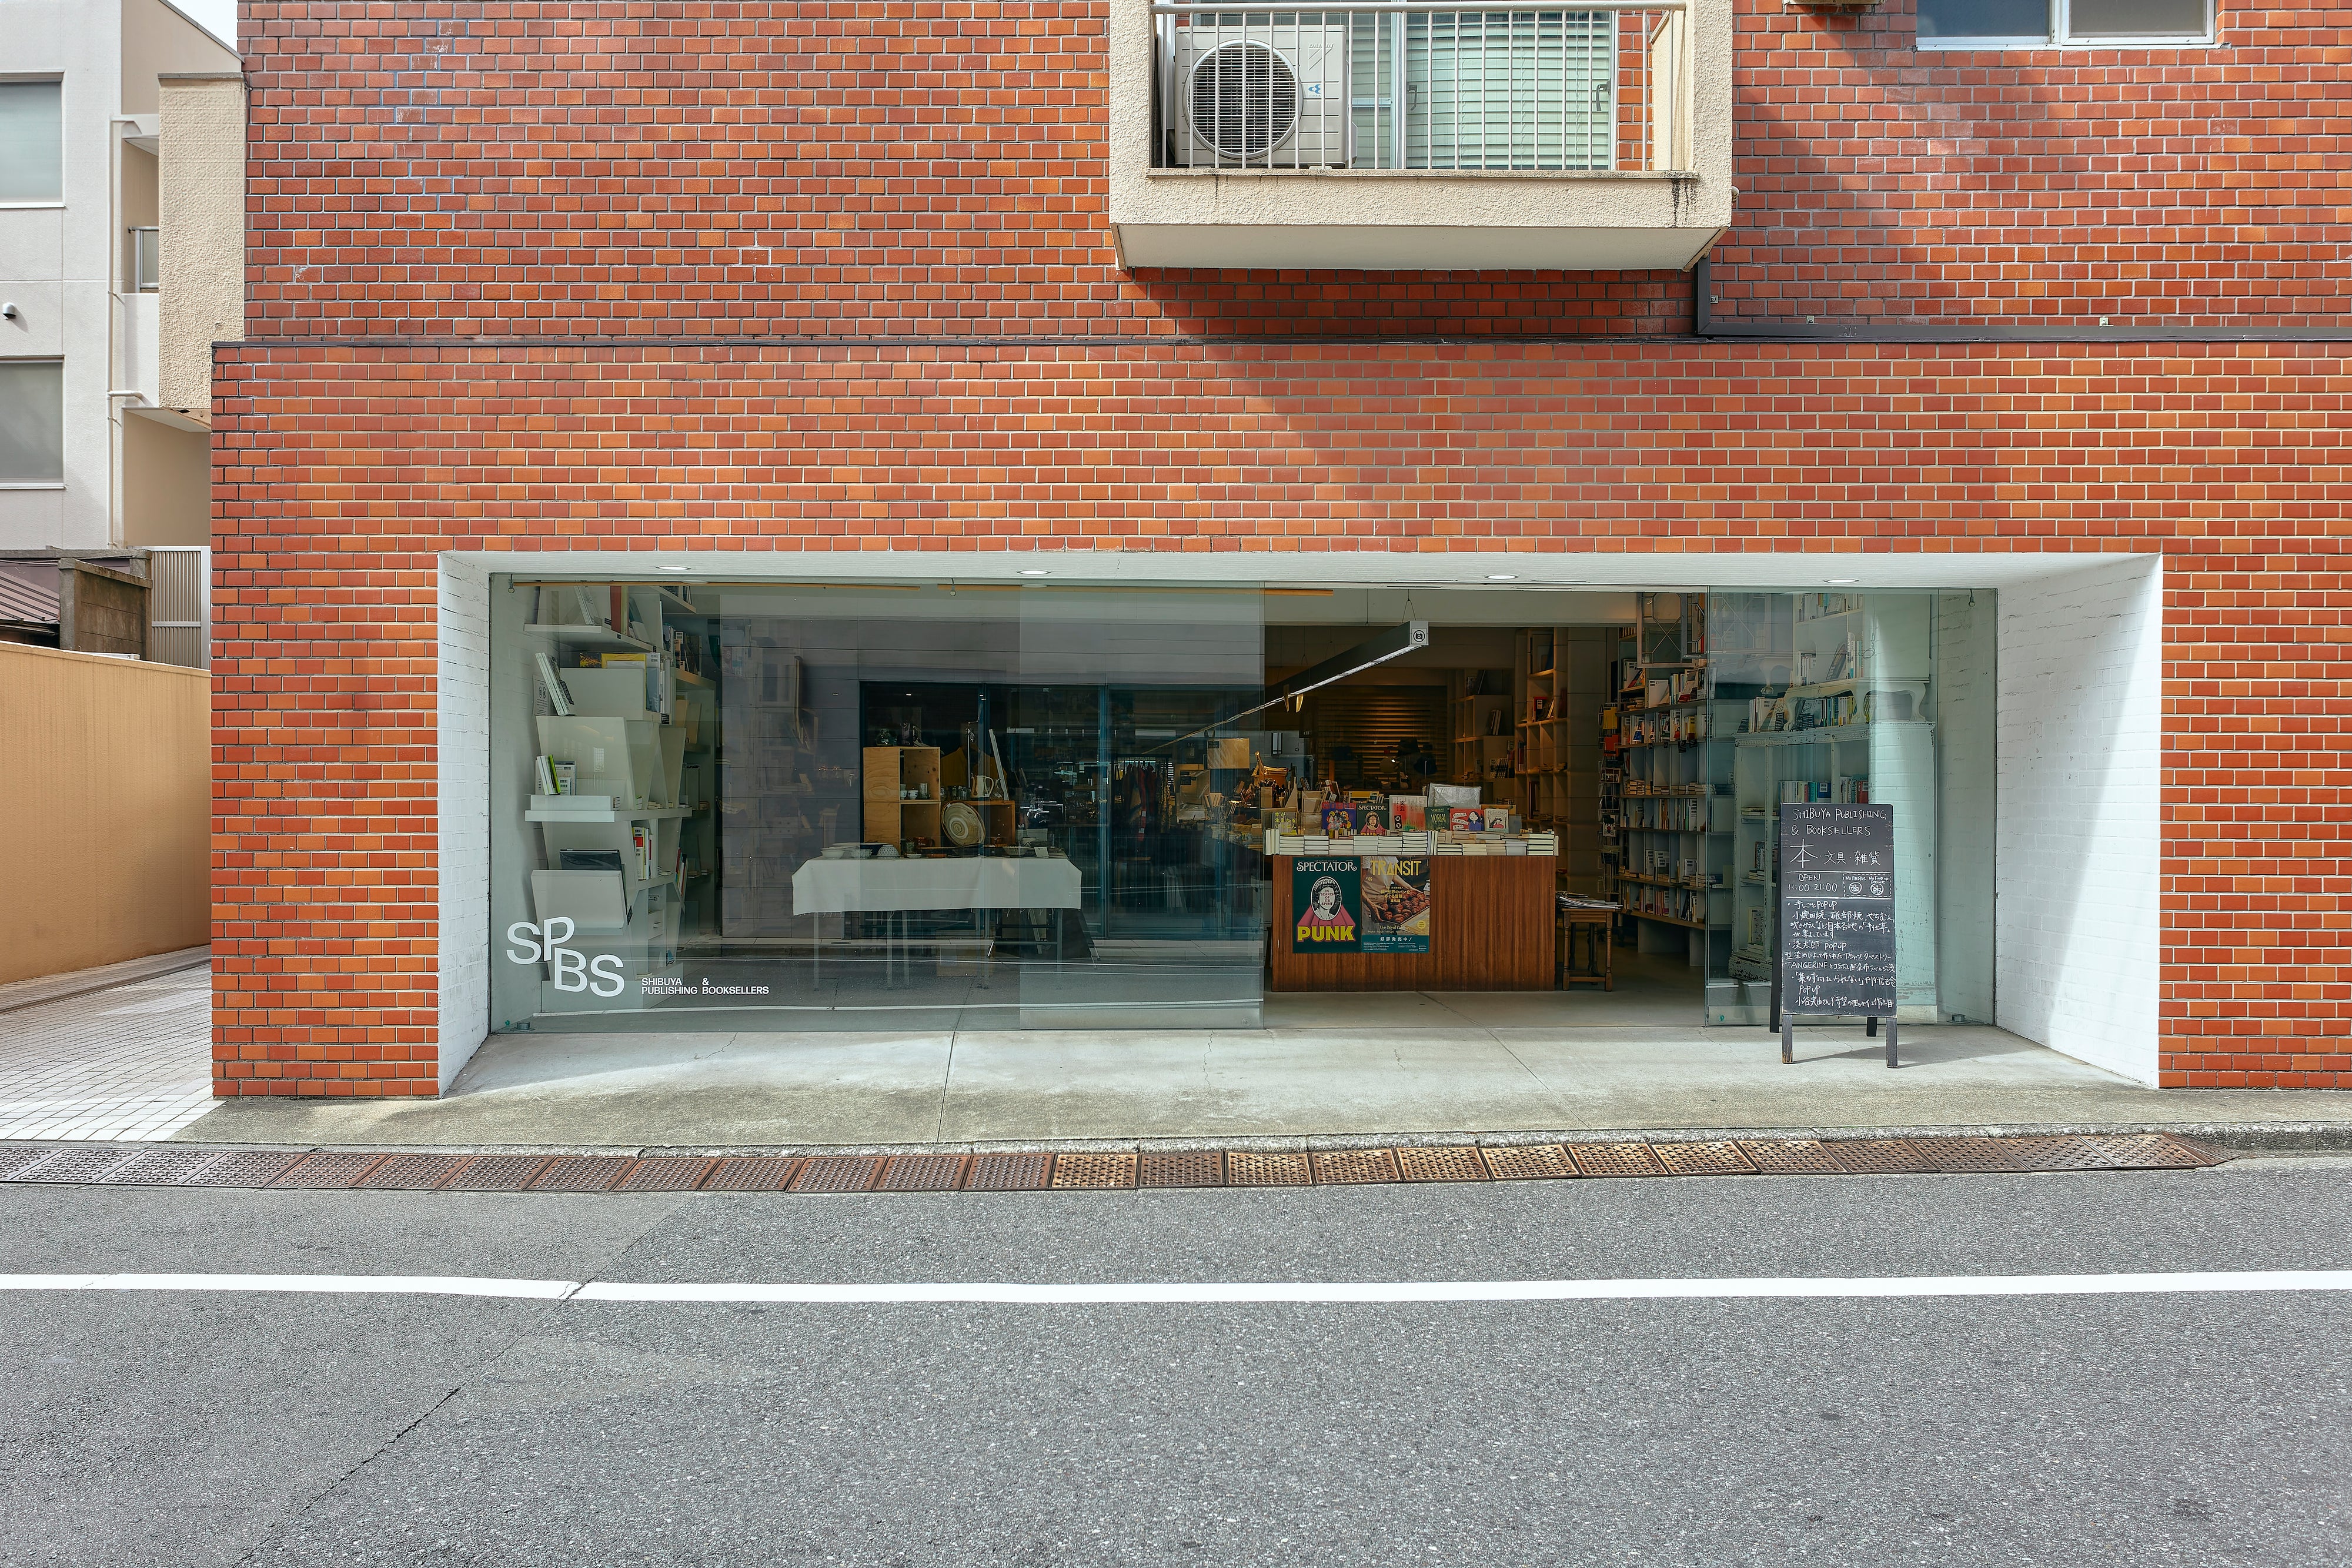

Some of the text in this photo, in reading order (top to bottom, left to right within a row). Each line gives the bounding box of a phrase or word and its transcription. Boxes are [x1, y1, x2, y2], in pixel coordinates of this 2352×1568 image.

[1358, 803, 1387, 811] SPECTATOR
[1792, 808, 1887, 821] SHIBUYA PUBLISHING
[1791, 825, 1871, 836] & BOOKSELLERS
[1297, 862, 1357, 871] SPECTATOR
[1371, 860, 1422, 875] TRANSIT
[1298, 925, 1354, 941] PUNK
[642, 977, 709, 986] SHIBUYA &
[642, 986, 769, 995] PUBLISHING BOOKSELLERS
